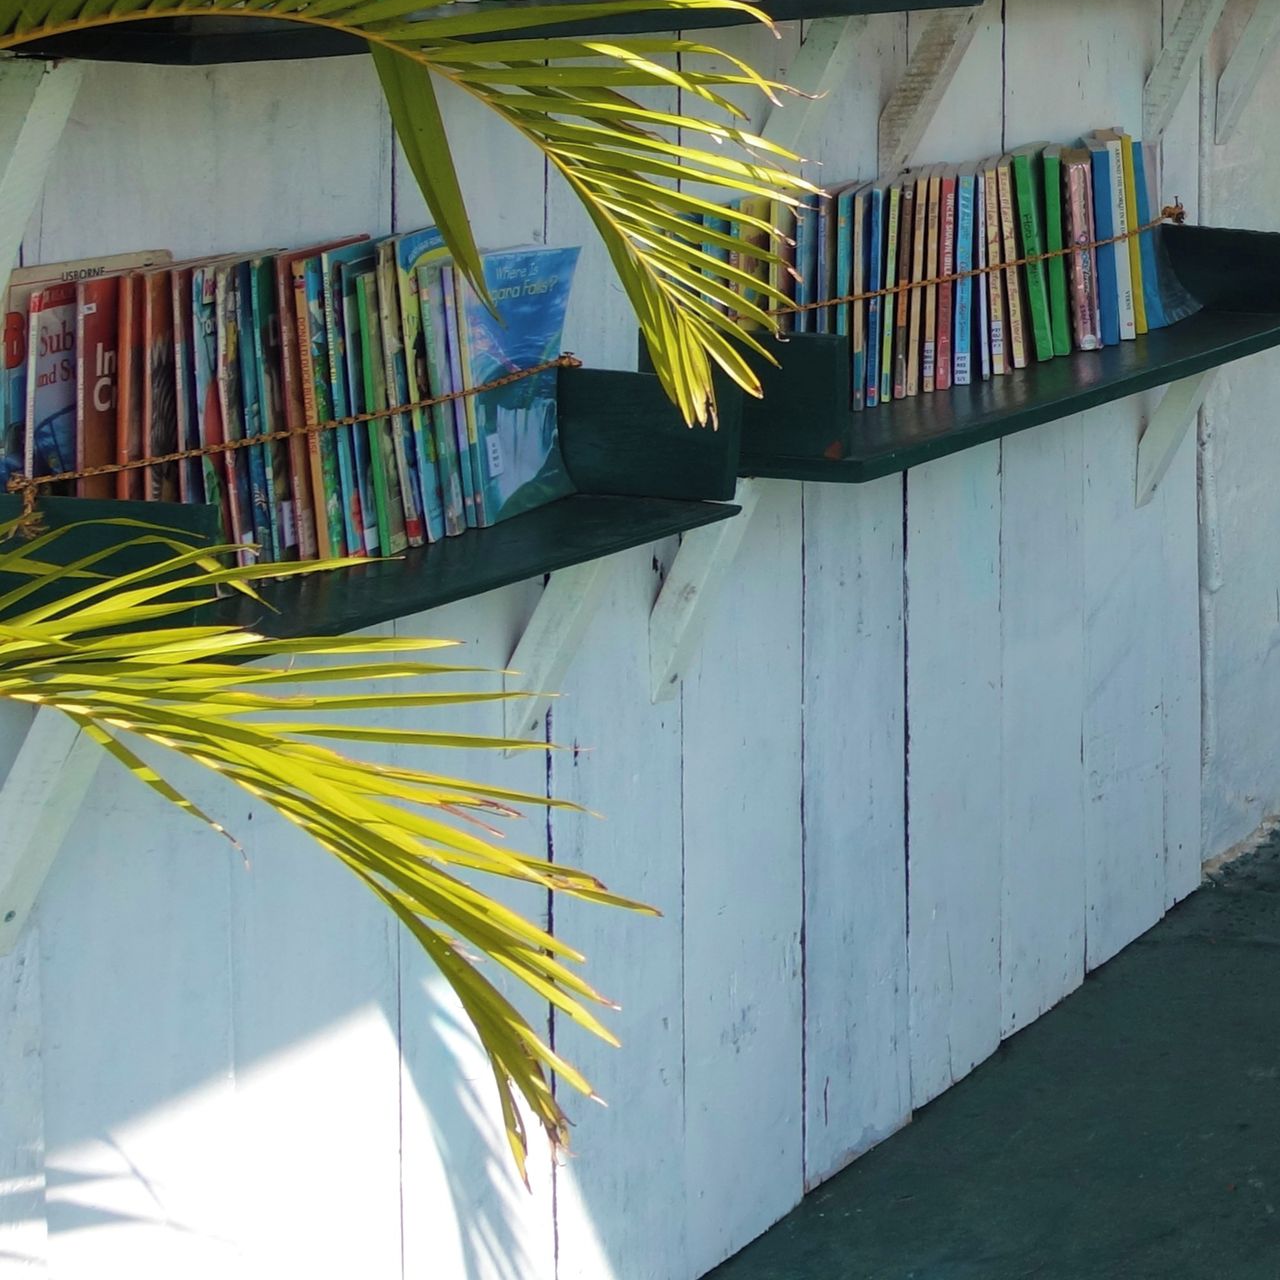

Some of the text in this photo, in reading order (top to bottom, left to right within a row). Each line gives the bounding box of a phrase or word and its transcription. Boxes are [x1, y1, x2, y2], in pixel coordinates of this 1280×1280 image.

[945, 193, 955, 224] UNCLE
[944, 224, 954, 253] SHAWN
[61, 267, 105, 282] USBORNE
[494, 262, 539, 281] Where Is
[523, 276, 560, 296] Falls?
[40, 320, 75, 358] Sub
[297, 317, 309, 357] DONALD
[300, 358, 311, 385] DUCK
[302, 387, 313, 412] BUYS
[306, 424, 318, 456] OUSE
